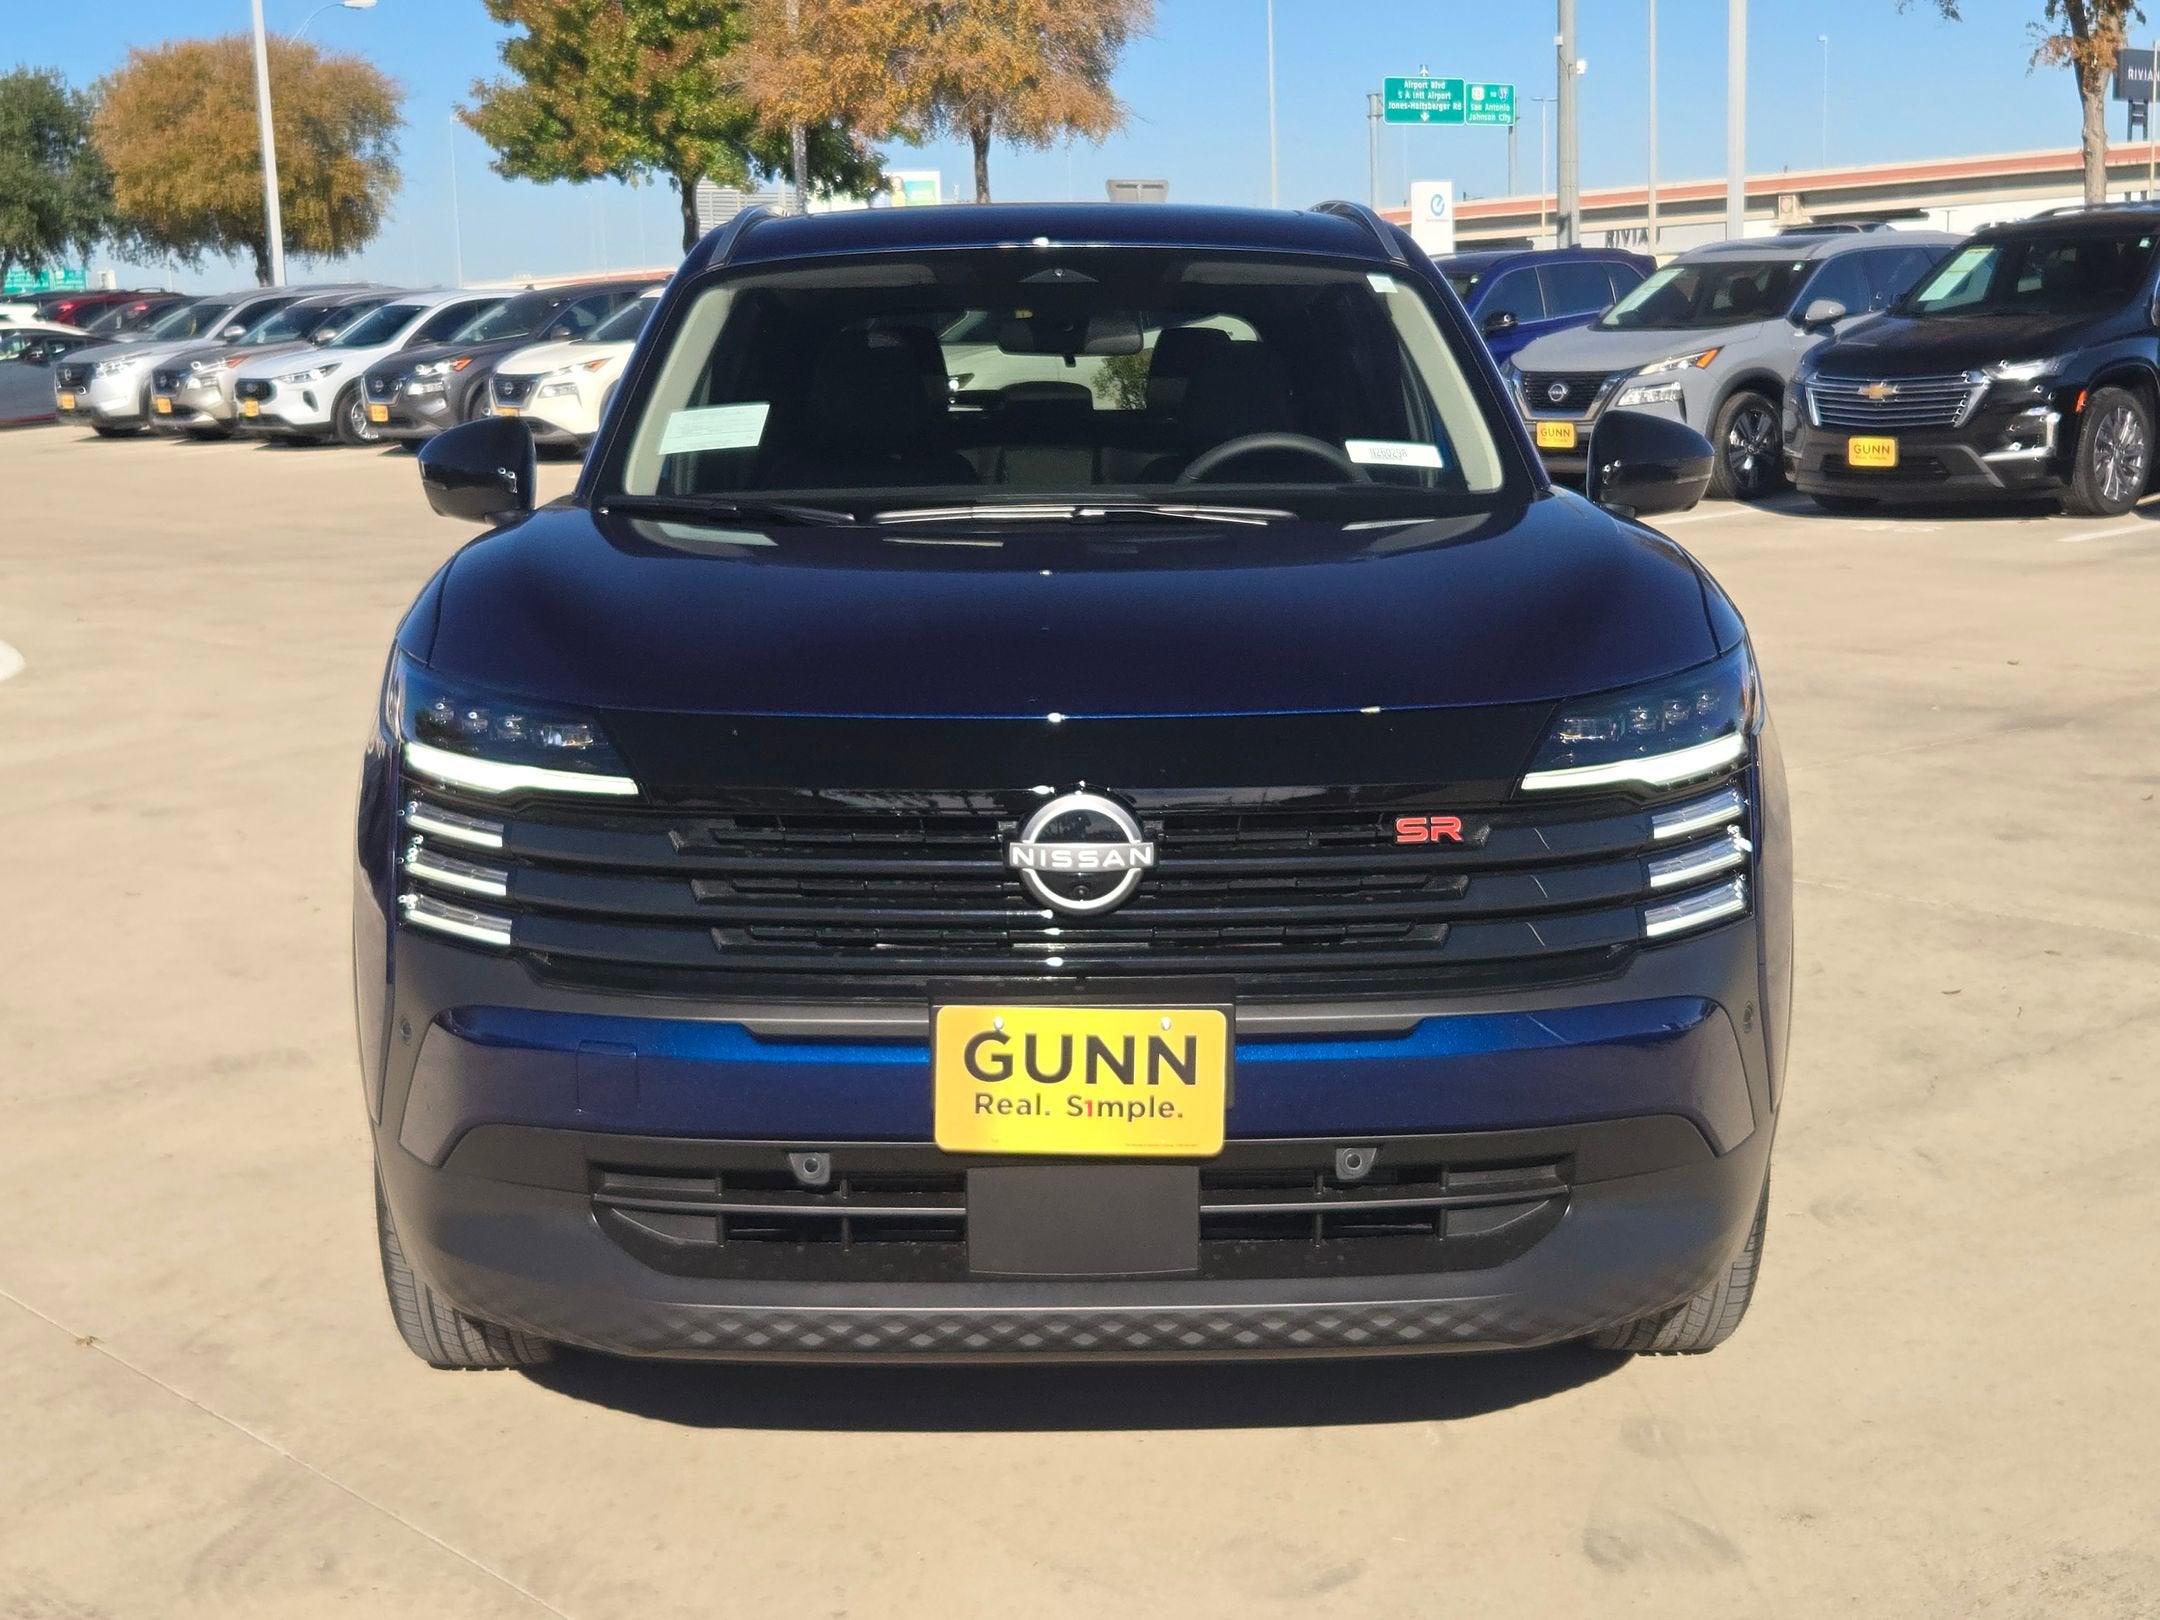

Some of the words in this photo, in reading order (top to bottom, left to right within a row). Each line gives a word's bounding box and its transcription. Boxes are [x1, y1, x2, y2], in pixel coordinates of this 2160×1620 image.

[1404, 80, 1428, 90] Airport
[1430, 80, 1446, 89] Blvd
[1398, 91, 1403, 99] S
[1405, 91, 1411, 99] A
[1427, 92, 1451, 101] Airport
[1453, 103, 1462, 111] Rd
[1485, 103, 1510, 112] Antonio
[1468, 112, 1496, 121] Johnson
[1540, 427, 1571, 438] GUNN
[1853, 444, 1890, 455] GUNN
[1396, 816, 1463, 842] SR
[1011, 846, 1152, 868] NISSAN
[963, 1030, 1197, 1086] GUNN
[974, 1092, 1051, 1116] Real.
